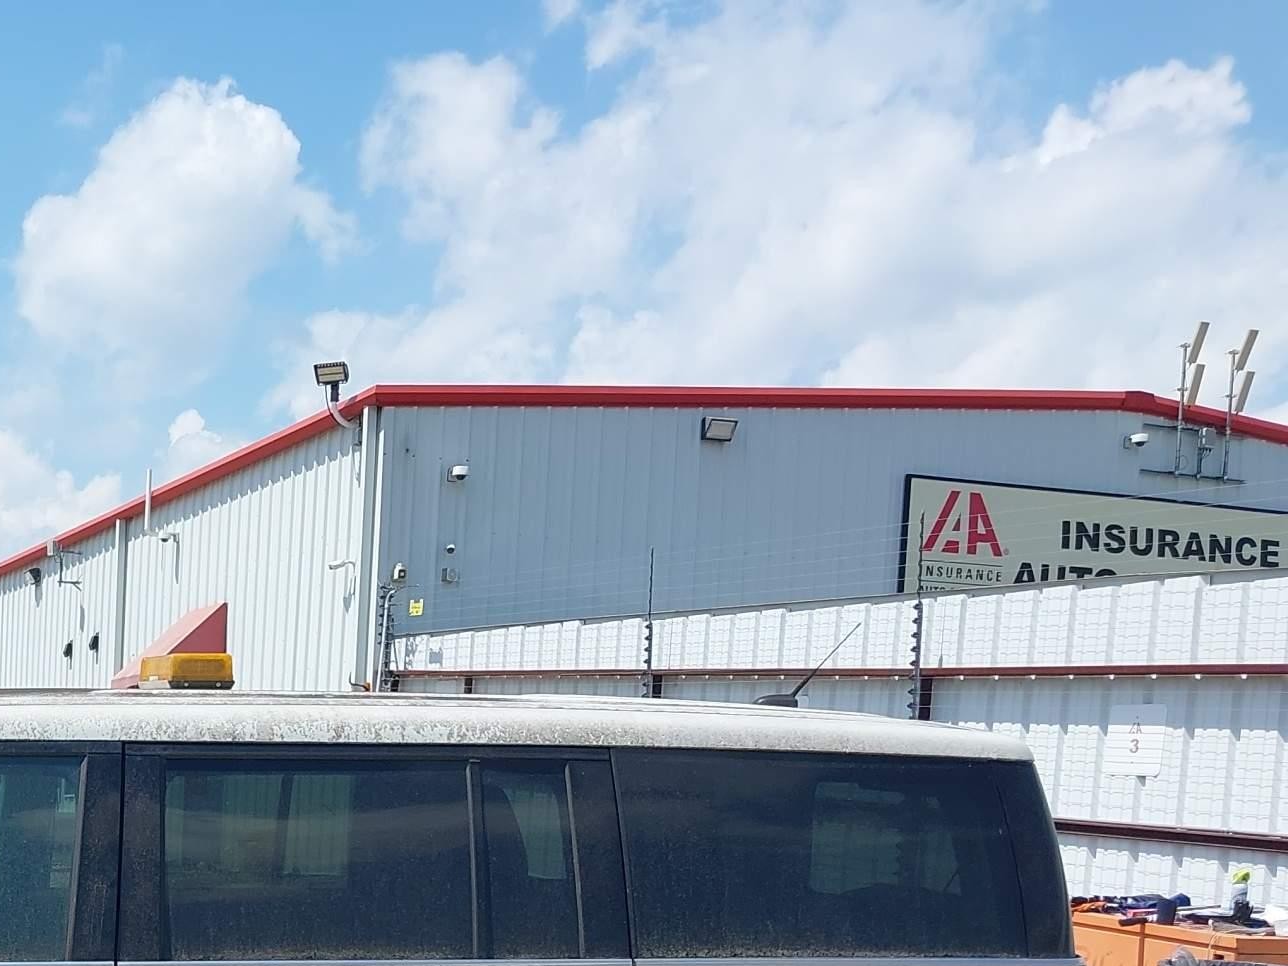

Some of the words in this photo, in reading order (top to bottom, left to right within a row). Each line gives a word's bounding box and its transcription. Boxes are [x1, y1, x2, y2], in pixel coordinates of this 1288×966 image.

[1060, 520, 1281, 568] INSURANCE
[924, 565, 1003, 582] NSURANCE
[1013, 562, 1118, 584] AUT
[1129, 738, 1140, 754] 3
